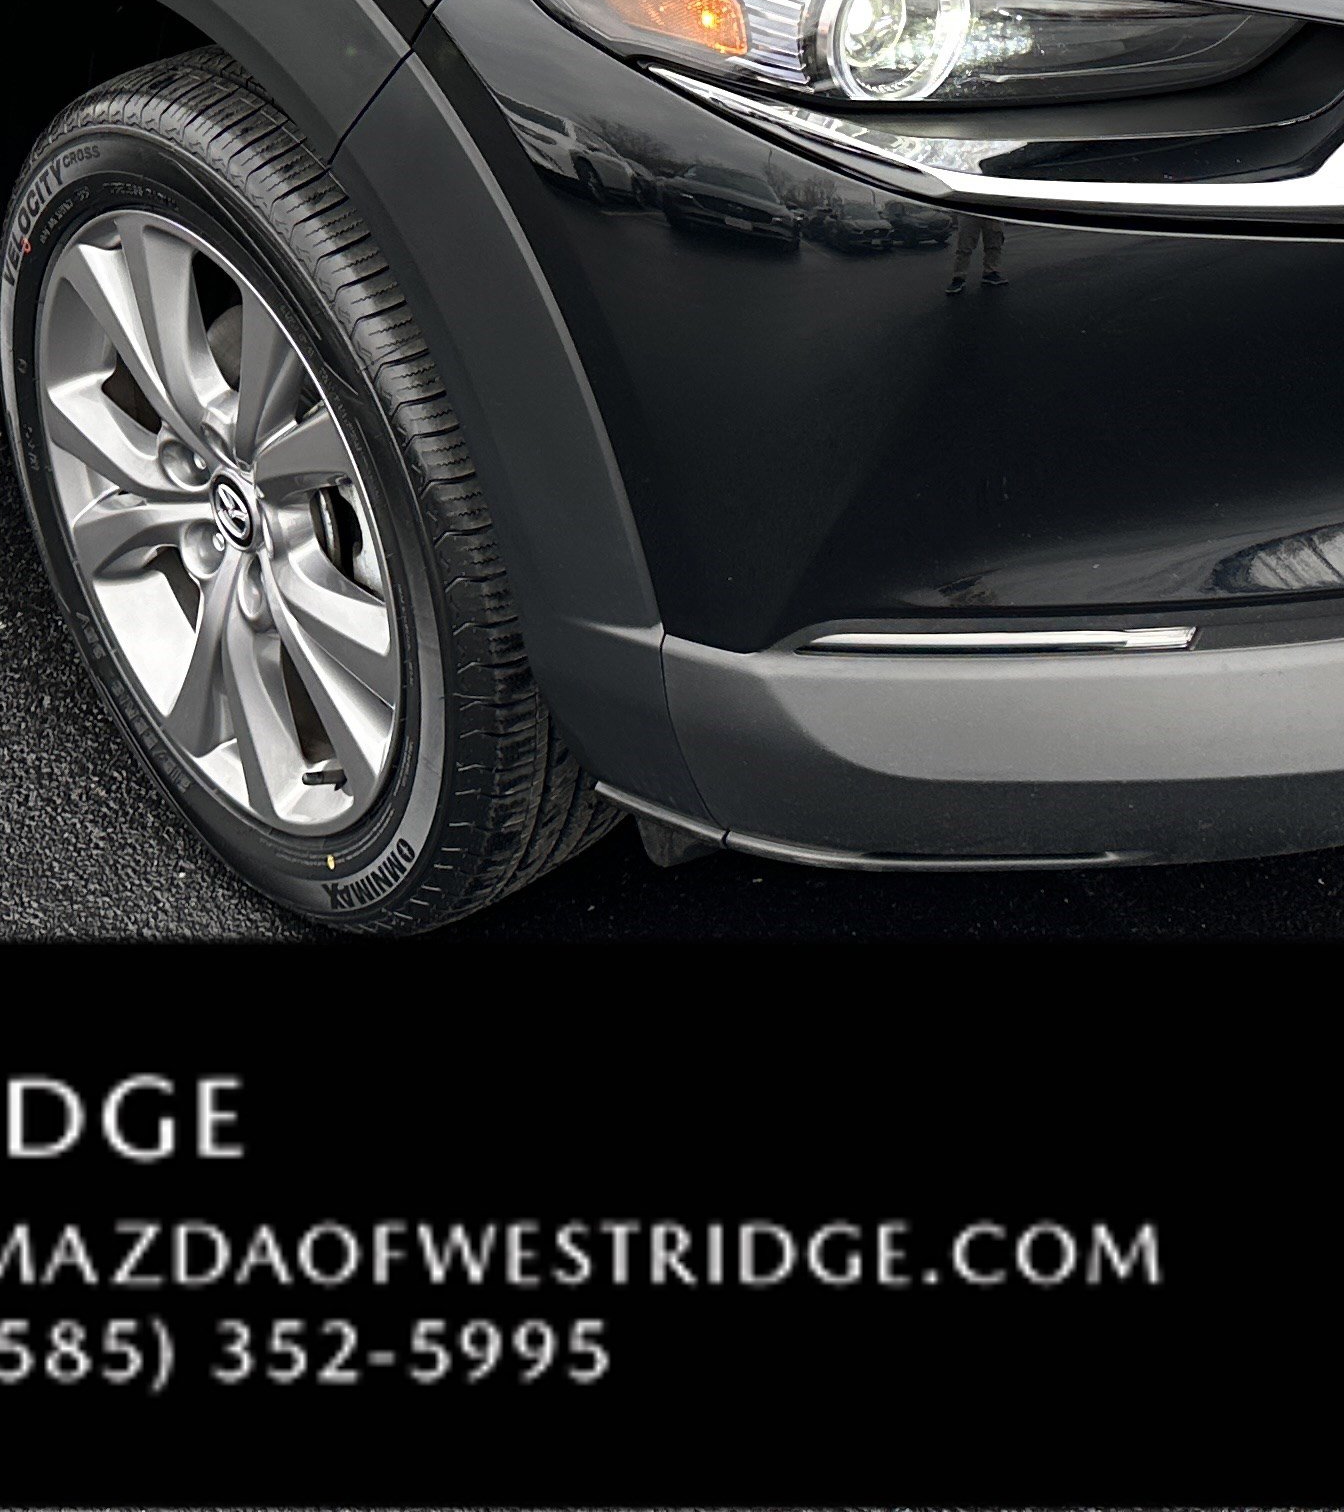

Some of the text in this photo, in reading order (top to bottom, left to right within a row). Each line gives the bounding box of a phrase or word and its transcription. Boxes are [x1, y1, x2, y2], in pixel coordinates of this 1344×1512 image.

[3, 157, 64, 287] VELOCITY
[62, 145, 101, 169] CROSS
[322, 838, 416, 909] OMNIMAX
